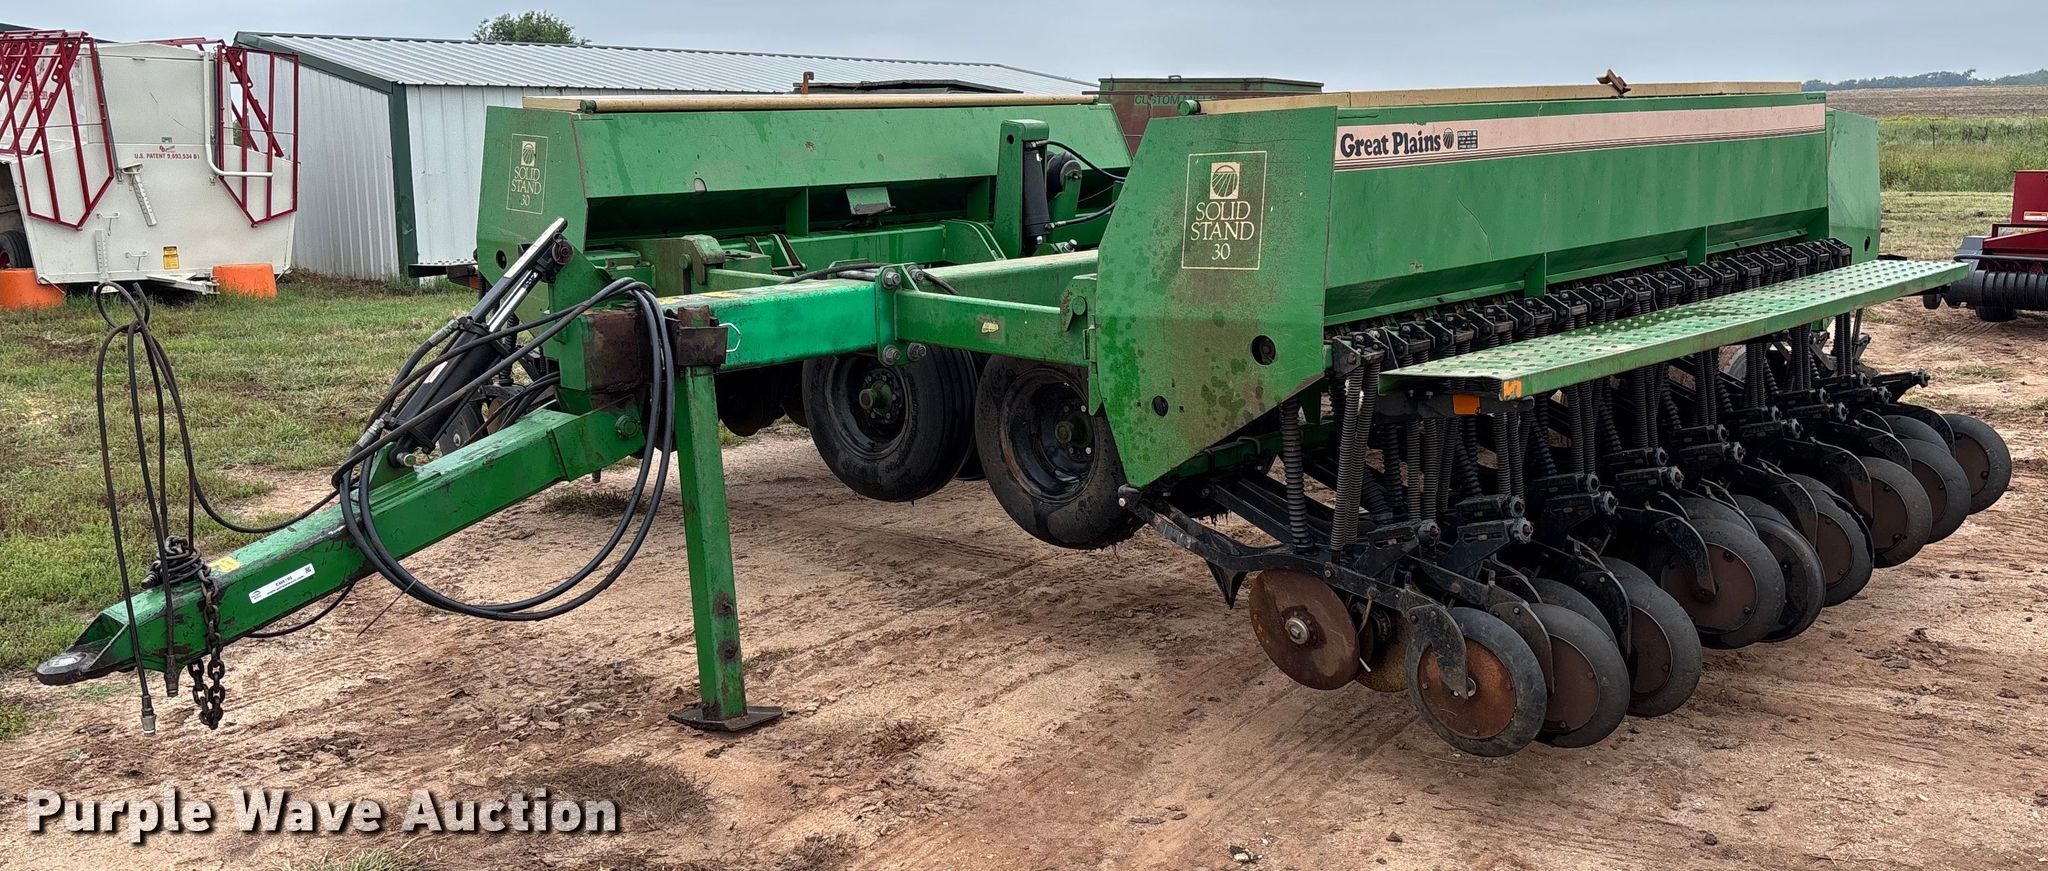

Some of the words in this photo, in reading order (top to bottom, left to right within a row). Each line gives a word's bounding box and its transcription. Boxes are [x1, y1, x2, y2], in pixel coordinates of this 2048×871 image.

[1135, 95, 1180, 105] CUSTOM
[1340, 133, 1389, 158] Great
[1392, 130, 1442, 155] Plains
[514, 166, 541, 181] SOLID
[511, 179, 542, 195] STAND
[520, 194, 531, 207] 30
[1195, 201, 1251, 221] SOLID
[1190, 221, 1255, 241] STAND
[1212, 242, 1231, 261] 30
